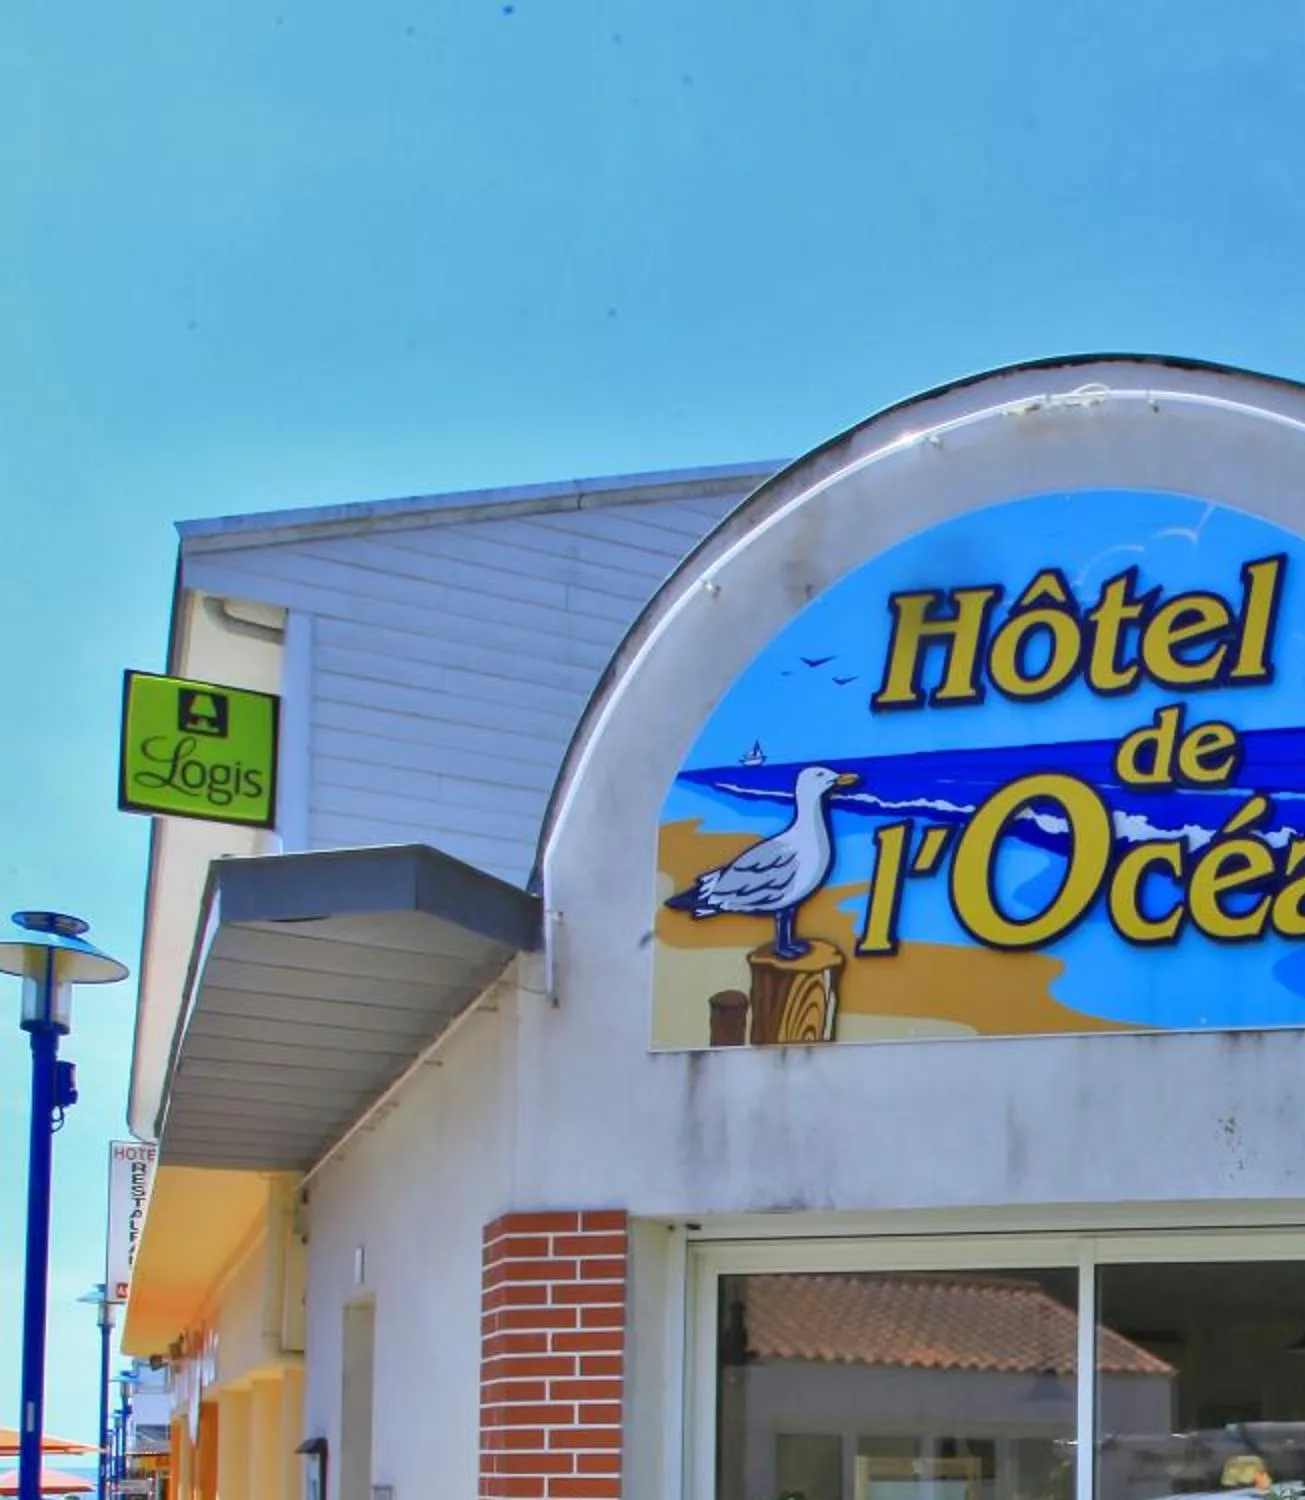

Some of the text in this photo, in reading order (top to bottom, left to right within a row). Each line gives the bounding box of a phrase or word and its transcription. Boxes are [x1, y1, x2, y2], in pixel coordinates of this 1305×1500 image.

[872, 553, 1286, 713] Hôtel
[134, 736, 263, 807] Logis
[1114, 704, 1242, 790] de
[113, 1147, 157, 1161] HOTE
